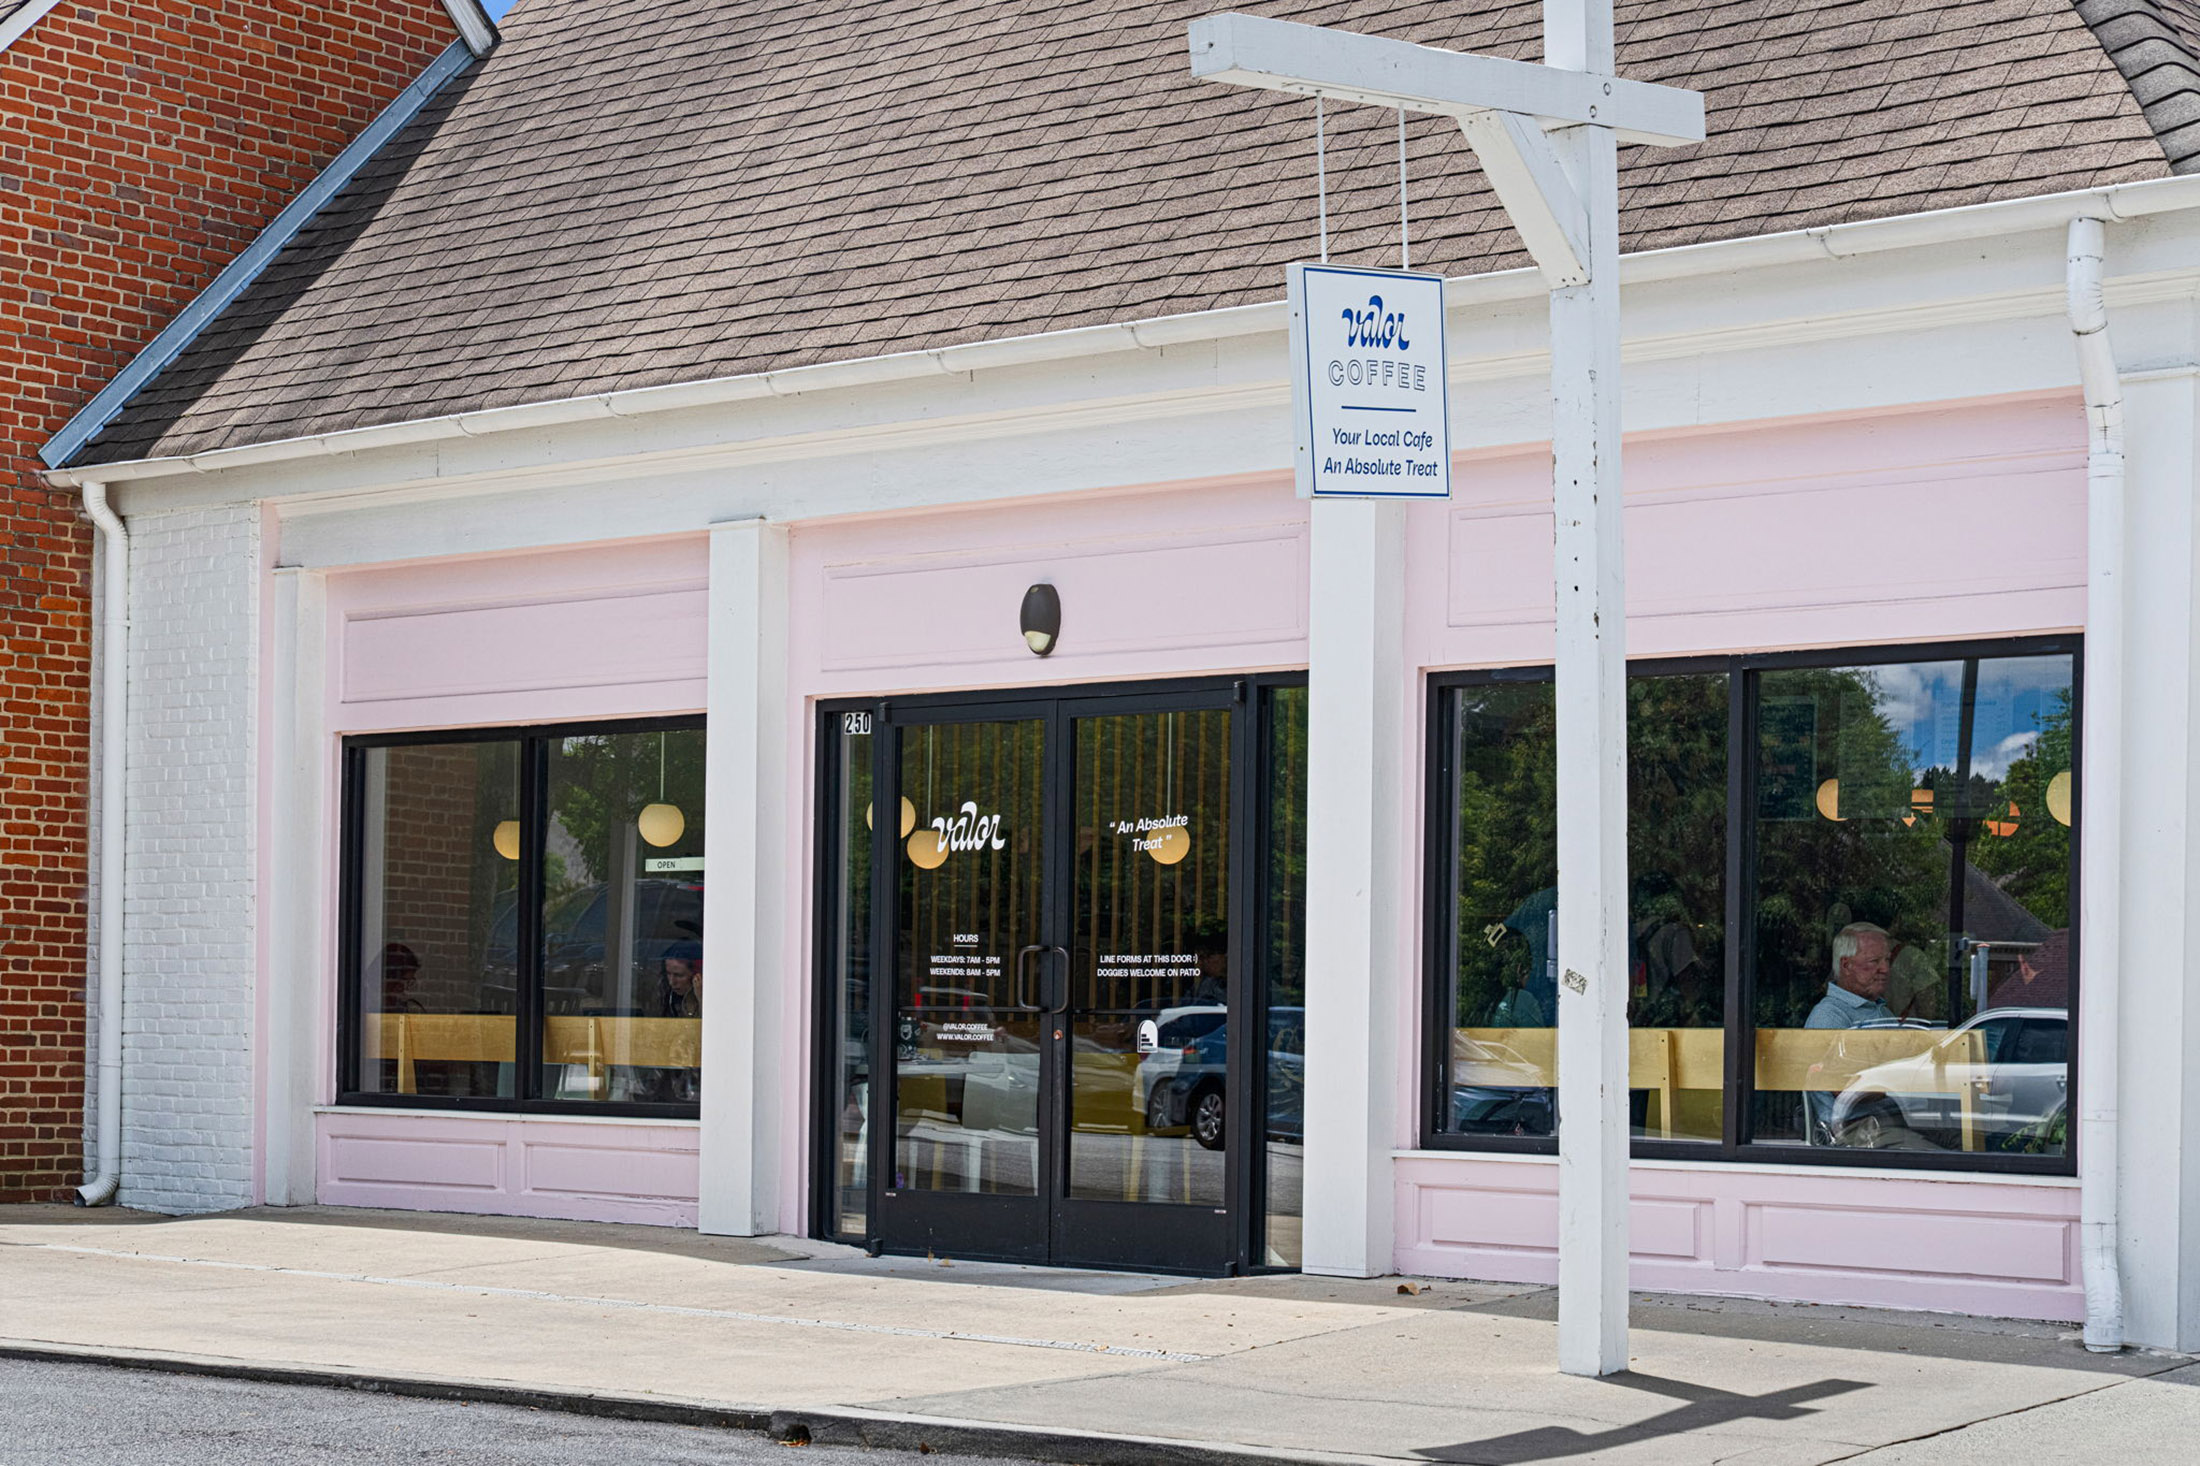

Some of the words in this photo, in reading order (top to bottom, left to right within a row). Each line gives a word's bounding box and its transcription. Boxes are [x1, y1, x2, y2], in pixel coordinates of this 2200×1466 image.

[1342, 295, 1410, 350] valor
[1328, 359, 1426, 391] COFFEE
[1332, 428, 1361, 445] Your
[1365, 429, 1400, 446] Local
[1403, 430, 1433, 451] Cafe
[1323, 457, 1341, 474] An
[1344, 457, 1402, 475] Absolute
[1405, 459, 1438, 476] Treat
[846, 713, 870, 733] 250
[1135, 813, 1188, 832] Absolute
[657, 860, 676, 869] OPEN
[953, 934, 979, 943] HOURS
[930, 955, 965, 964] WEEKDAYS:
[966, 955, 981, 964] 7AM
[986, 956, 1000, 964] 5PM
[1100, 955, 1116, 963] LINE
[1117, 955, 1142, 963] FORMS
[1143, 955, 1152, 963] AT
[1154, 955, 1170, 963] THIS
[1171, 954, 1192, 963] DOOR
[930, 967, 965, 976] WEEKENDS:
[966, 968, 981, 976] 8AM
[986, 968, 1001, 976] 5PM
[1097, 968, 1129, 977] DOGGIES
[1130, 968, 1166, 976] WELCOME
[1167, 968, 1178, 976] ON
[1179, 968, 1201, 976] PATIO
[936, 1033, 994, 1041] WWW.VALOR.COFFEE
